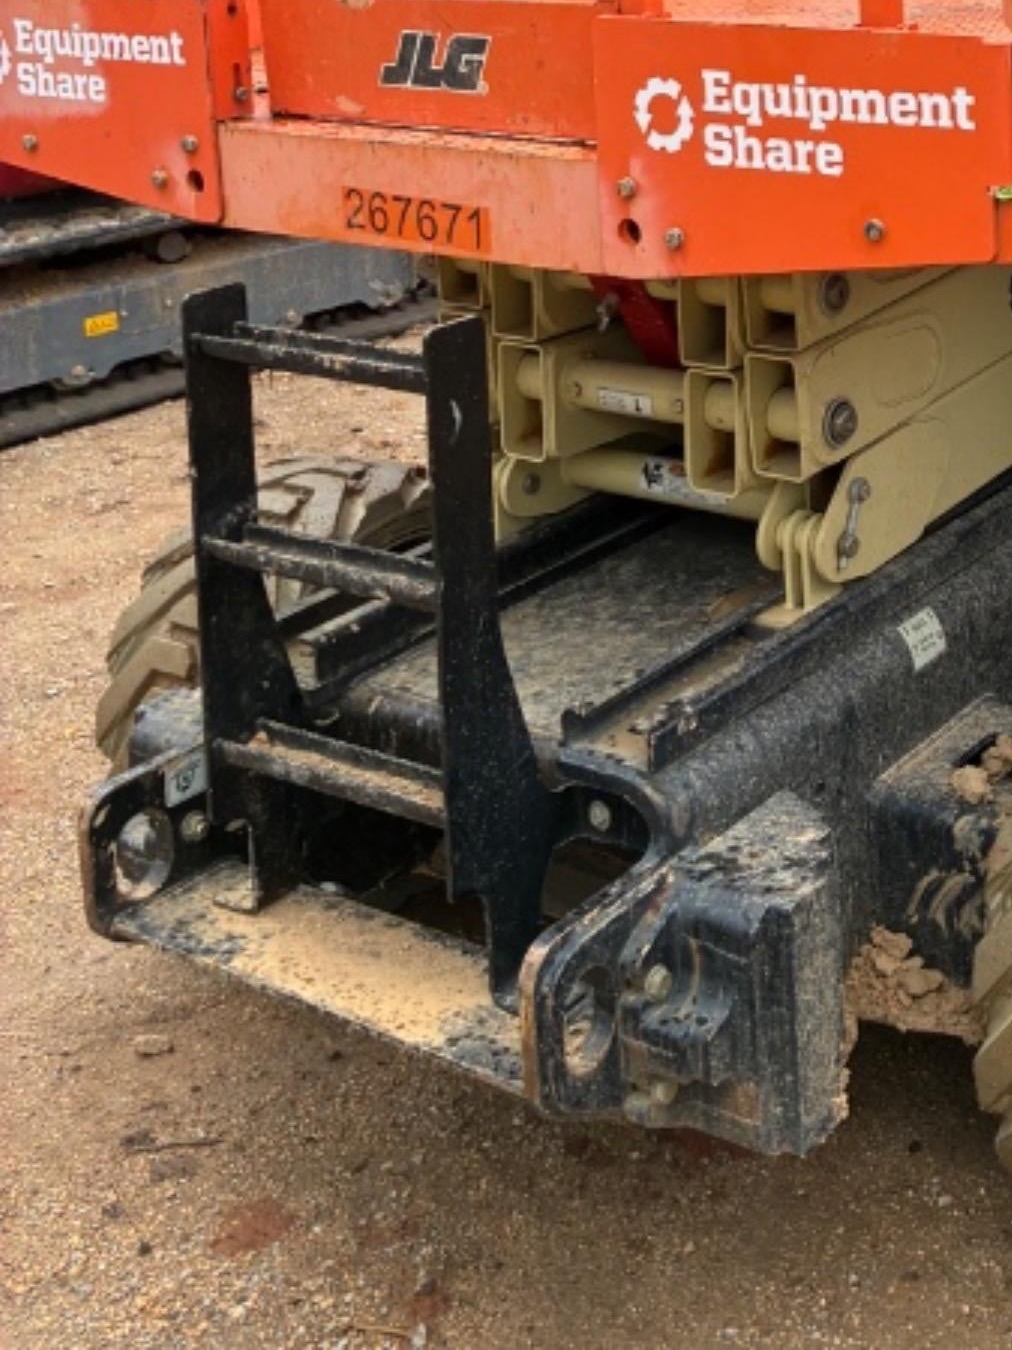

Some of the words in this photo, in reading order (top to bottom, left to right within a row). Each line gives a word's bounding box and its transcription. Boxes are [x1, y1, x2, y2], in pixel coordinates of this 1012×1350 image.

[14, 19, 186, 66] Equipment
[378, 29, 492, 94] JLG
[17, 61, 106, 103] Share
[701, 69, 976, 131] Equipment
[703, 123, 844, 177] Share
[344, 187, 484, 250] 267671
